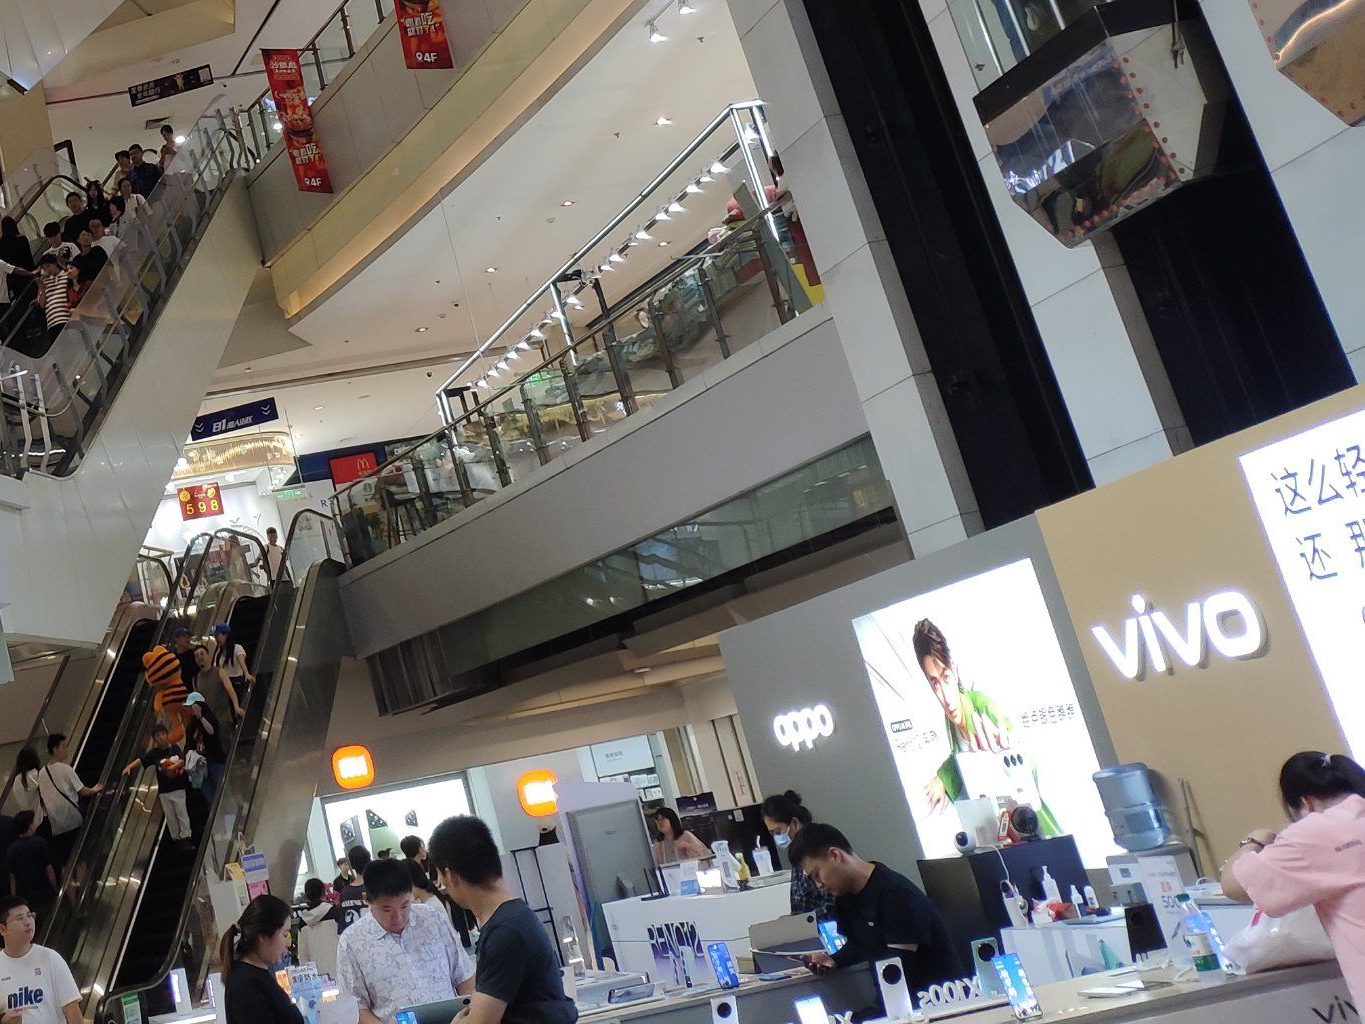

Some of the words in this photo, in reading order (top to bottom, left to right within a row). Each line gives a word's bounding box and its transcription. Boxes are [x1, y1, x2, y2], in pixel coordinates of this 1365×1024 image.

[424, 52, 438, 63] 4F
[1092, 593, 1263, 680] vivo
[773, 704, 834, 752] oppo
[7, 985, 44, 1010] nike
